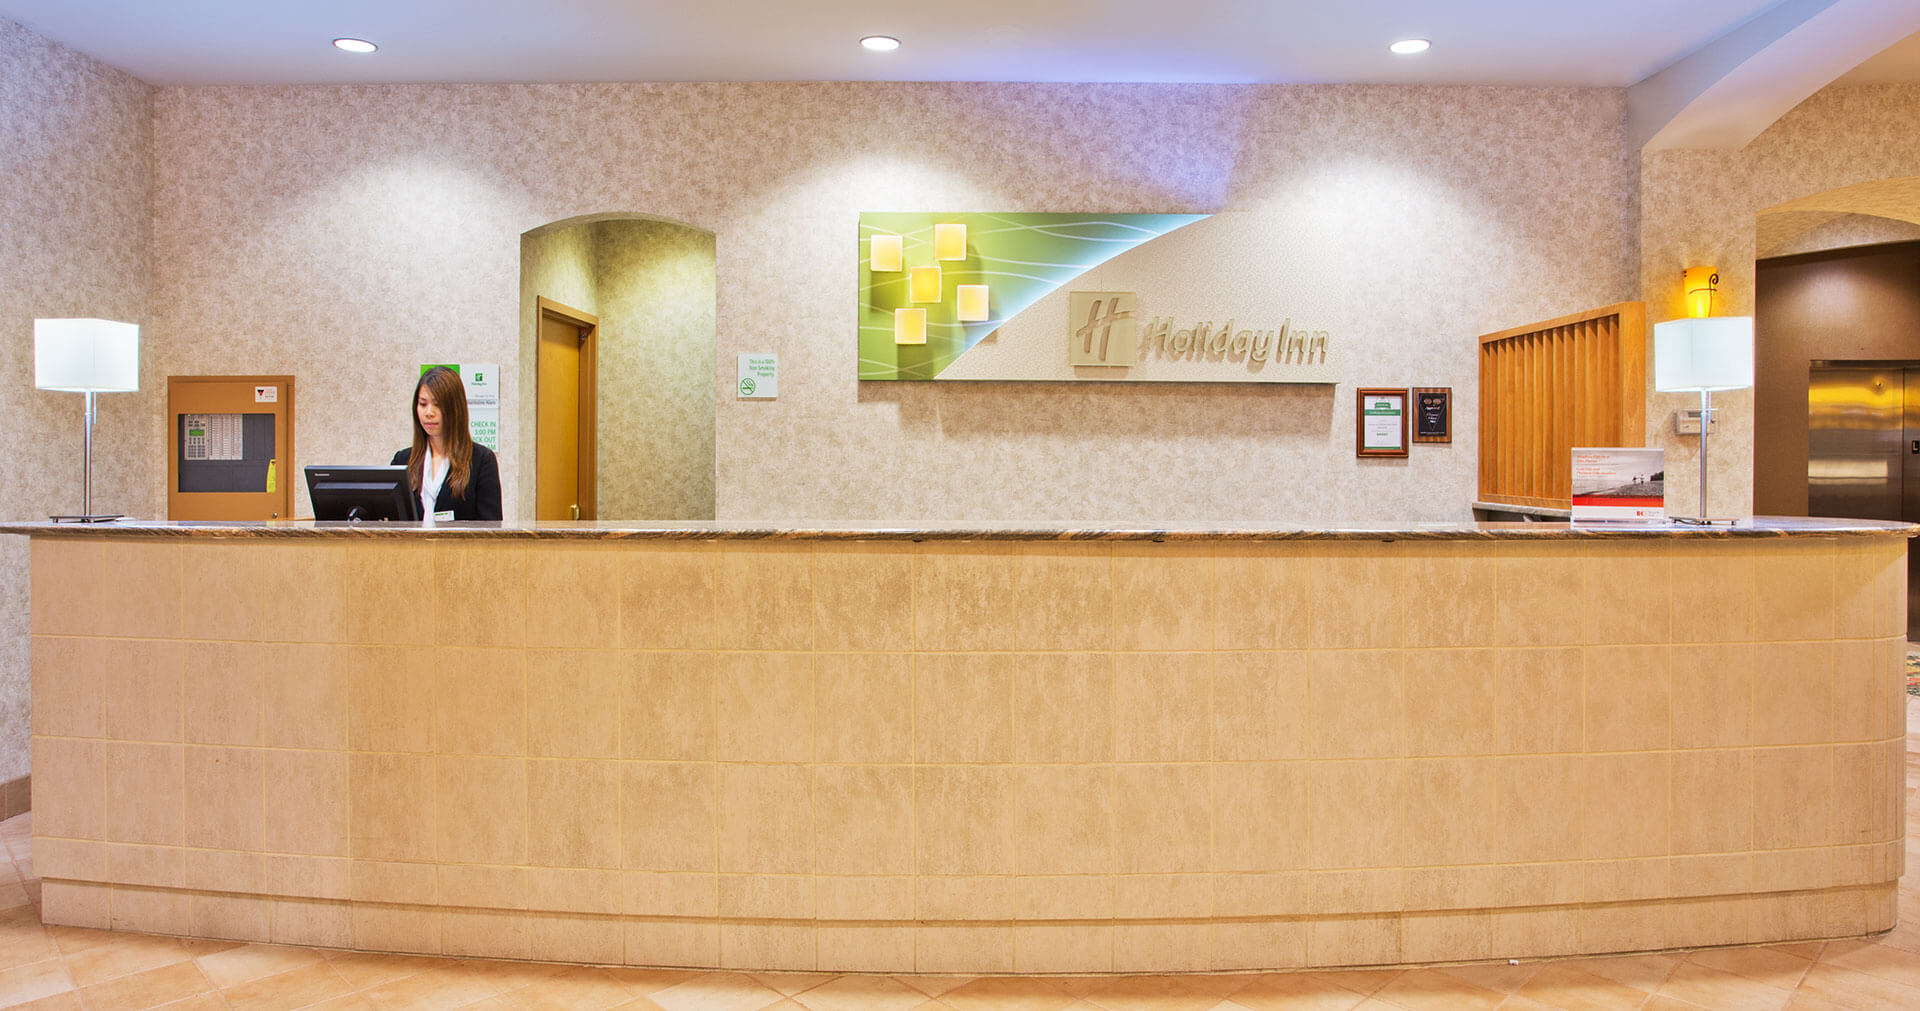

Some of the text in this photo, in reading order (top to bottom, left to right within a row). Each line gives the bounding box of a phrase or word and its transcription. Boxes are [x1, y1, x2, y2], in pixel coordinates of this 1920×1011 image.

[1142, 316, 1274, 363] Holiday
[1278, 317, 1329, 355] Inn
[1913, 442, 1918, 451] L
